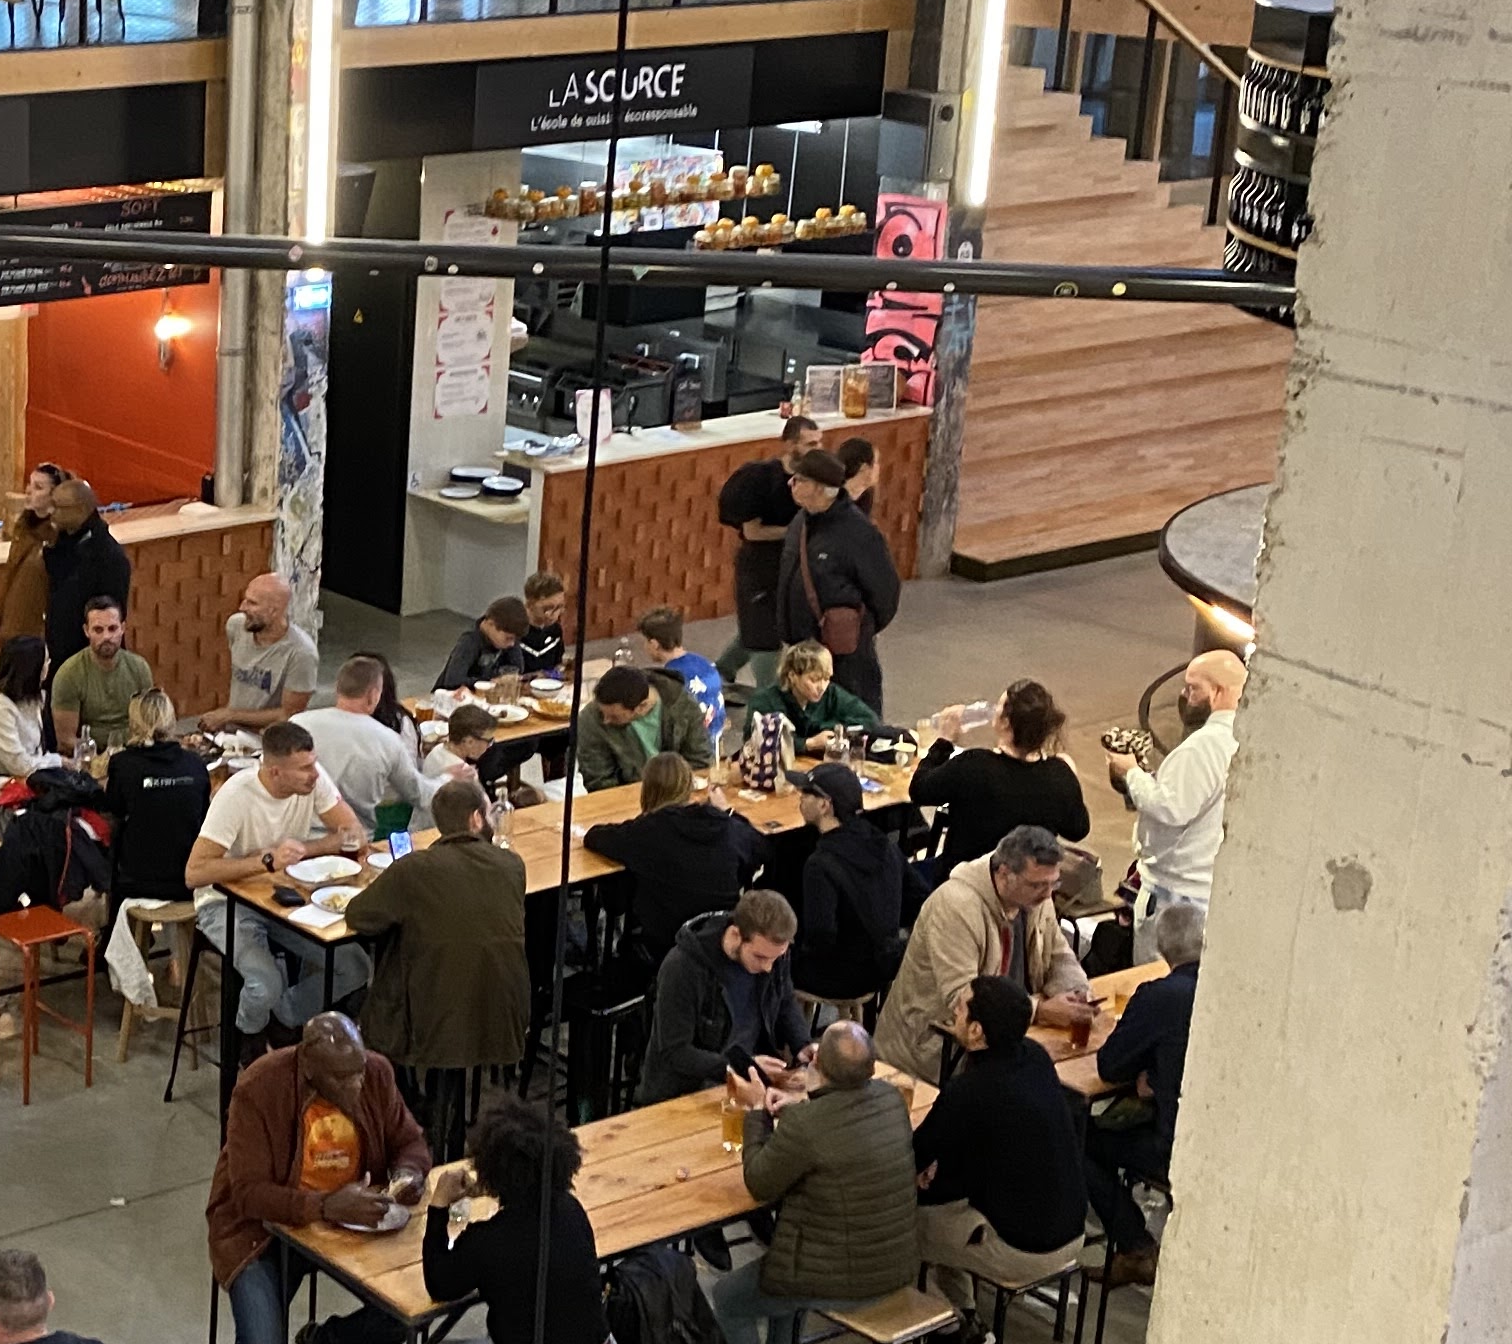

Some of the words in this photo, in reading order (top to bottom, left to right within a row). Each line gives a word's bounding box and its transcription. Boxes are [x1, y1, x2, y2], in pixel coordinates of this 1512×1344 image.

[549, 72, 579, 107] LA
[584, 63, 686, 105] SOURCE
[570, 113, 583, 128] de
[585, 112, 614, 127] cuisi
